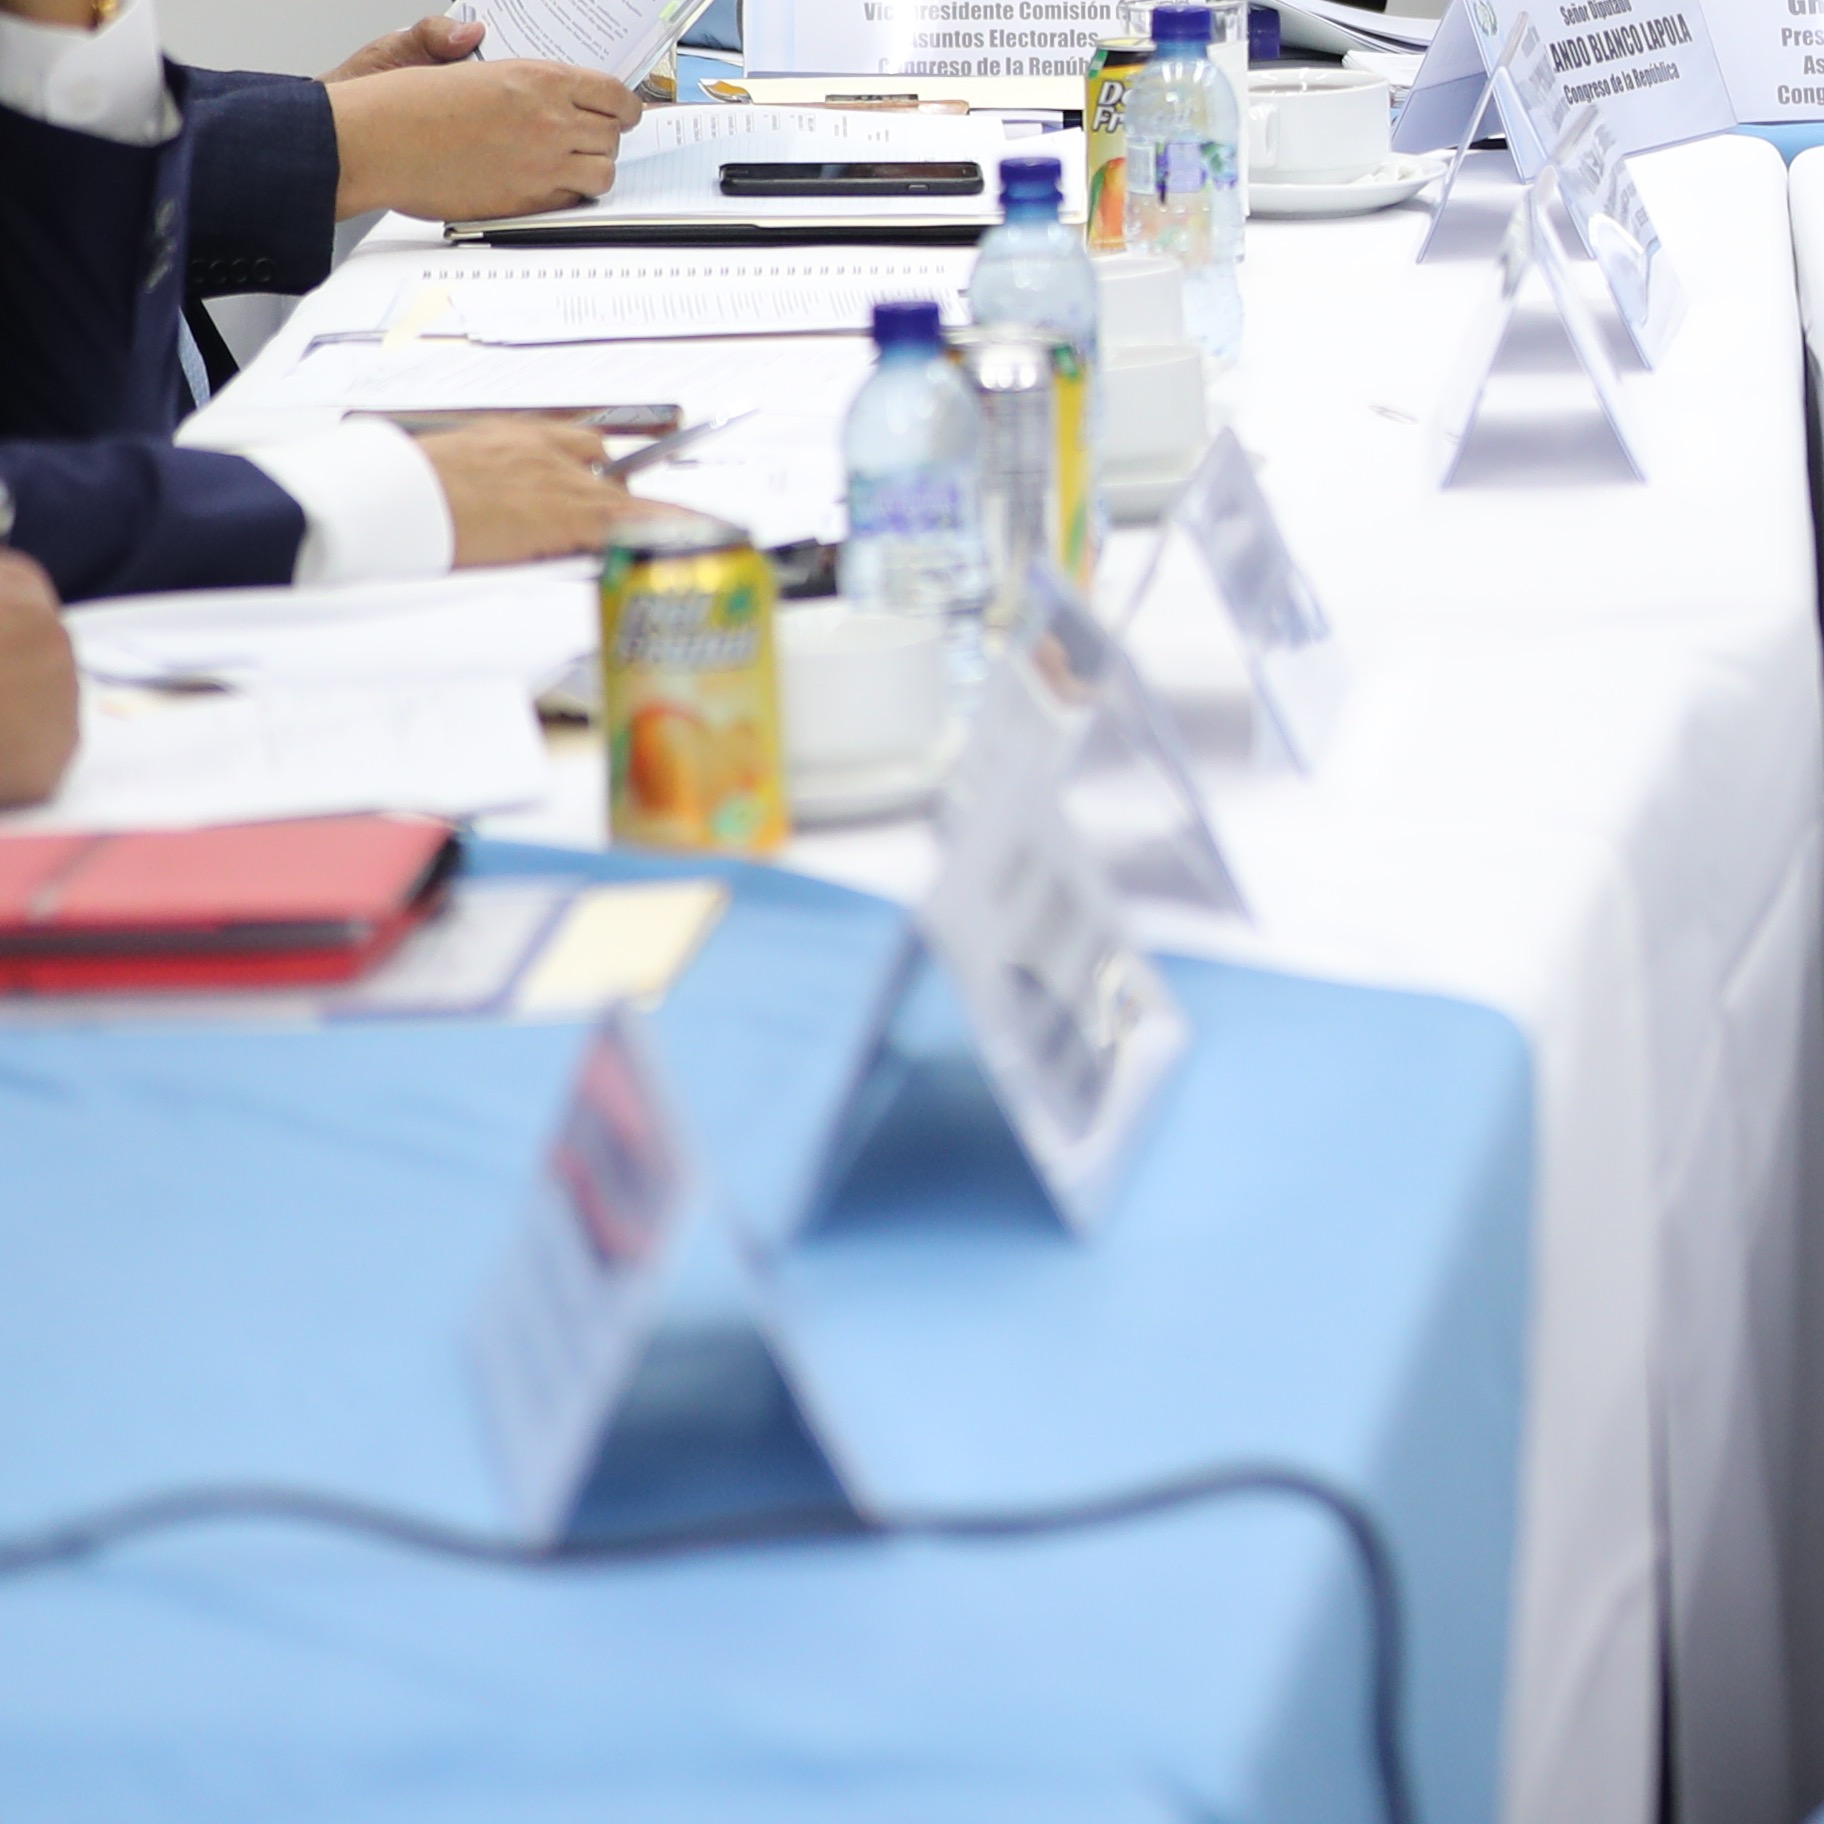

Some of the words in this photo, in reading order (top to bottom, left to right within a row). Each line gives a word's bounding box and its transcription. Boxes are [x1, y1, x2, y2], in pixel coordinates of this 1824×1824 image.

[1019, 1, 1111, 20] Comisión
[1560, 2, 1589, 26] Señor
[989, 28, 1099, 48] Electorales
[1587, 23, 1643, 64] BLANCO
[1642, 13, 1693, 53] LAPOLA
[878, 57, 971, 76] Cngreso
[977, 57, 1000, 76] de
[1005, 57, 1023, 76] la
[1029, 55, 1089, 76] Repúb
[1563, 78, 1611, 106] Congreso
[1610, 73, 1624, 95] de
[1621, 70, 1635, 91] la
[1633, 61, 1680, 91] República
